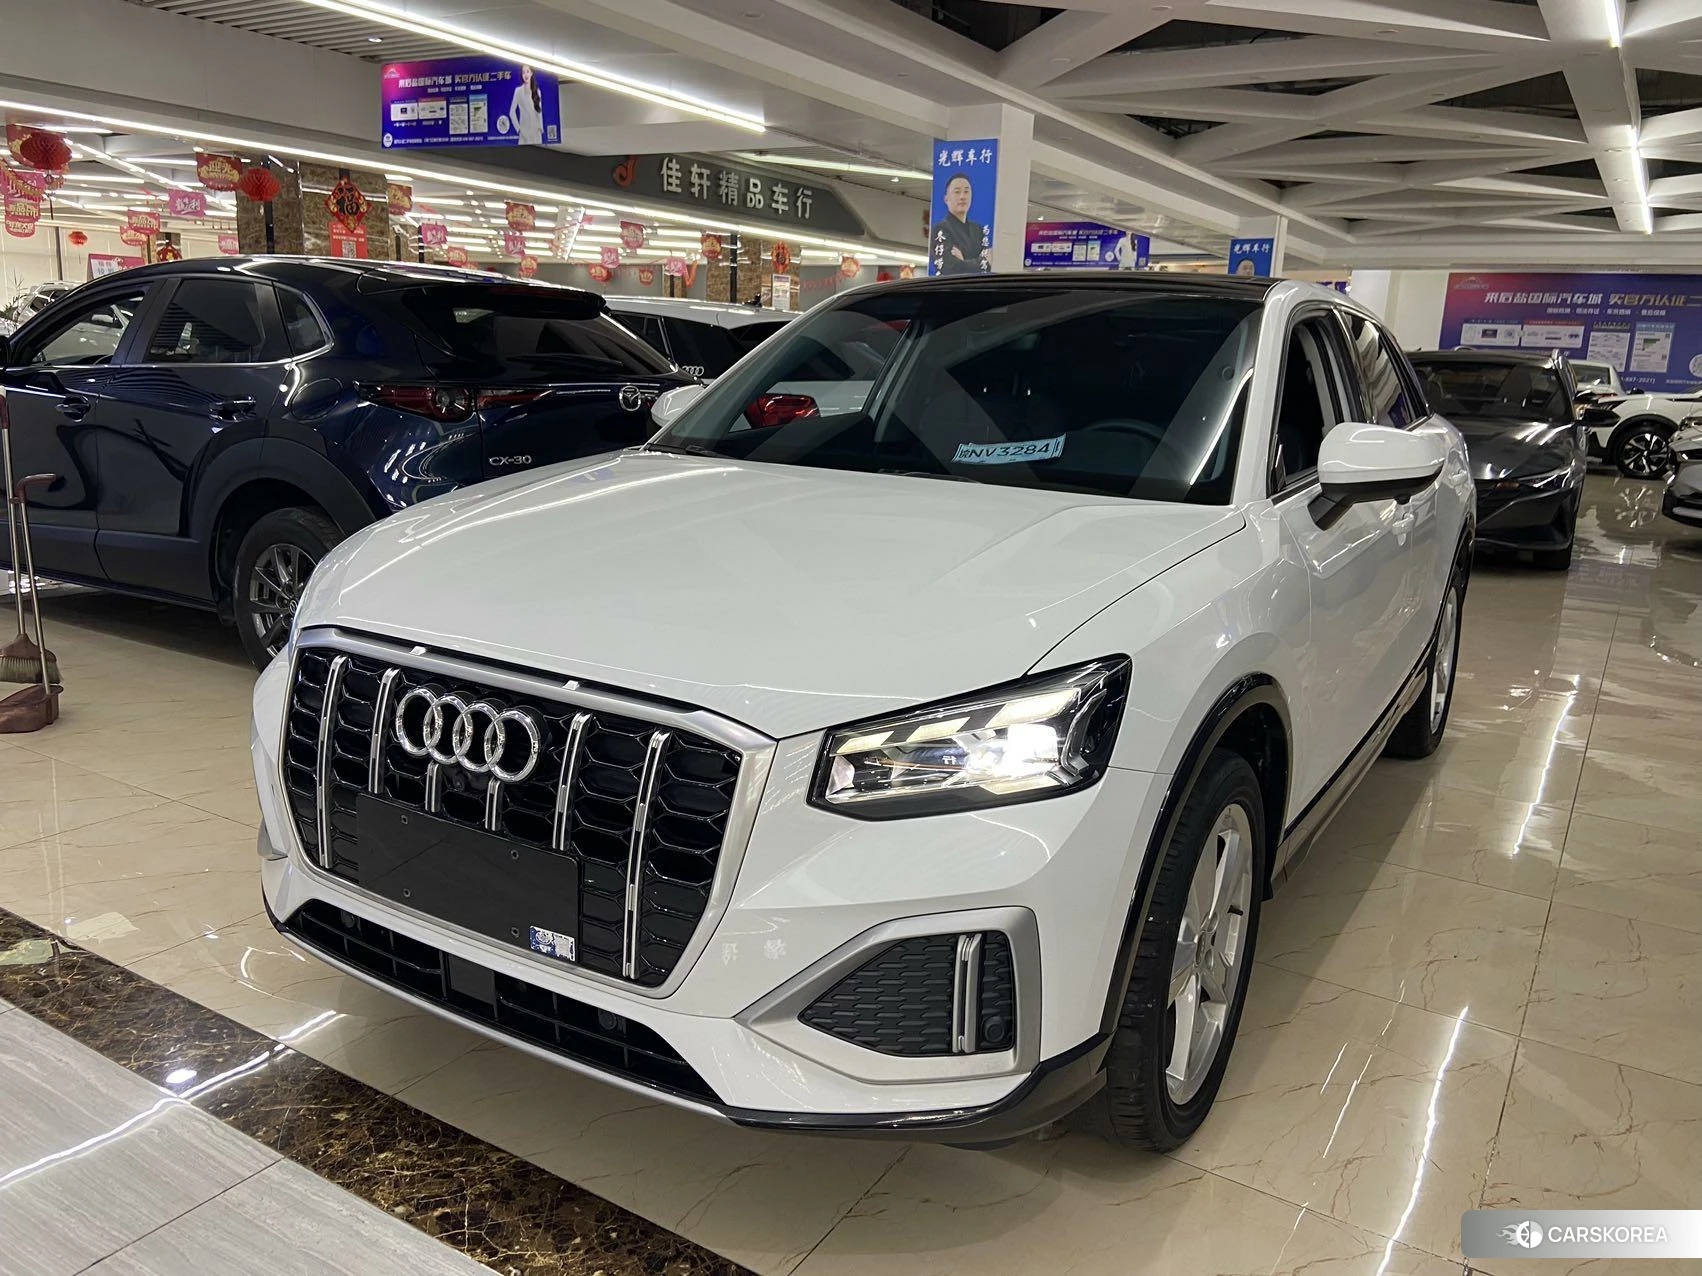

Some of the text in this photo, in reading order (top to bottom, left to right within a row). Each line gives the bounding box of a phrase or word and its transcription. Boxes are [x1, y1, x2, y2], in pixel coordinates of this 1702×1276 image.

[661, 156, 813, 219] 佳轩精品车行
[488, 455, 532, 466] CX-30
